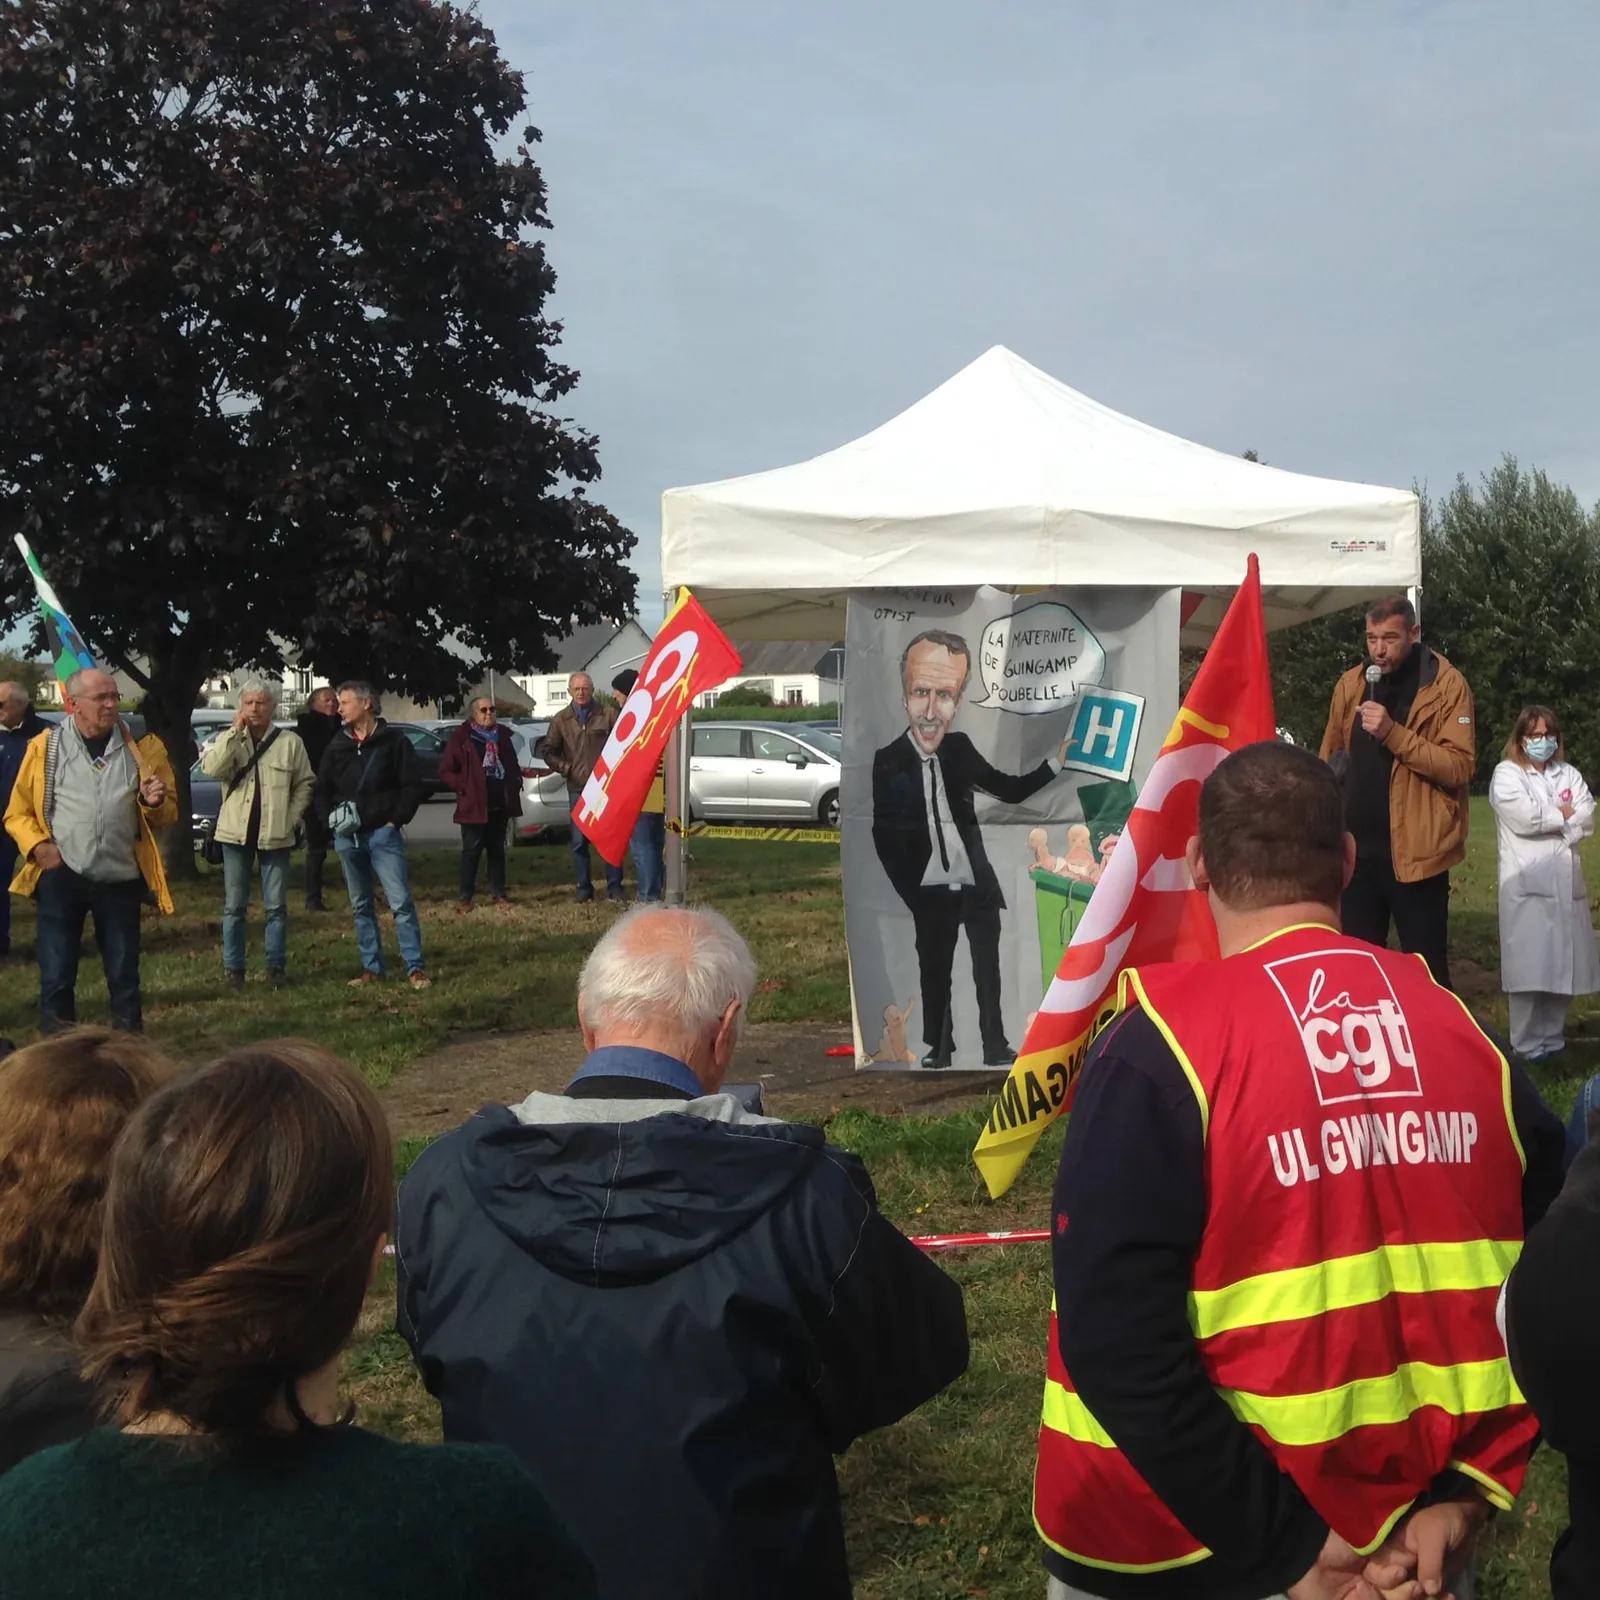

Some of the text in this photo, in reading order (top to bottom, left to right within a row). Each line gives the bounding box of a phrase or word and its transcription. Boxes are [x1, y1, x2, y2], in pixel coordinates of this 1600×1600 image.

[988, 627, 1076, 649] LA MATERNITE
[985, 652, 1078, 678] DE GUINGAMP
[1081, 705, 1125, 759] H
[1300, 968, 1384, 1021] la
[1303, 999, 1415, 1088] cgt
[1267, 1128, 1320, 1187] UL
